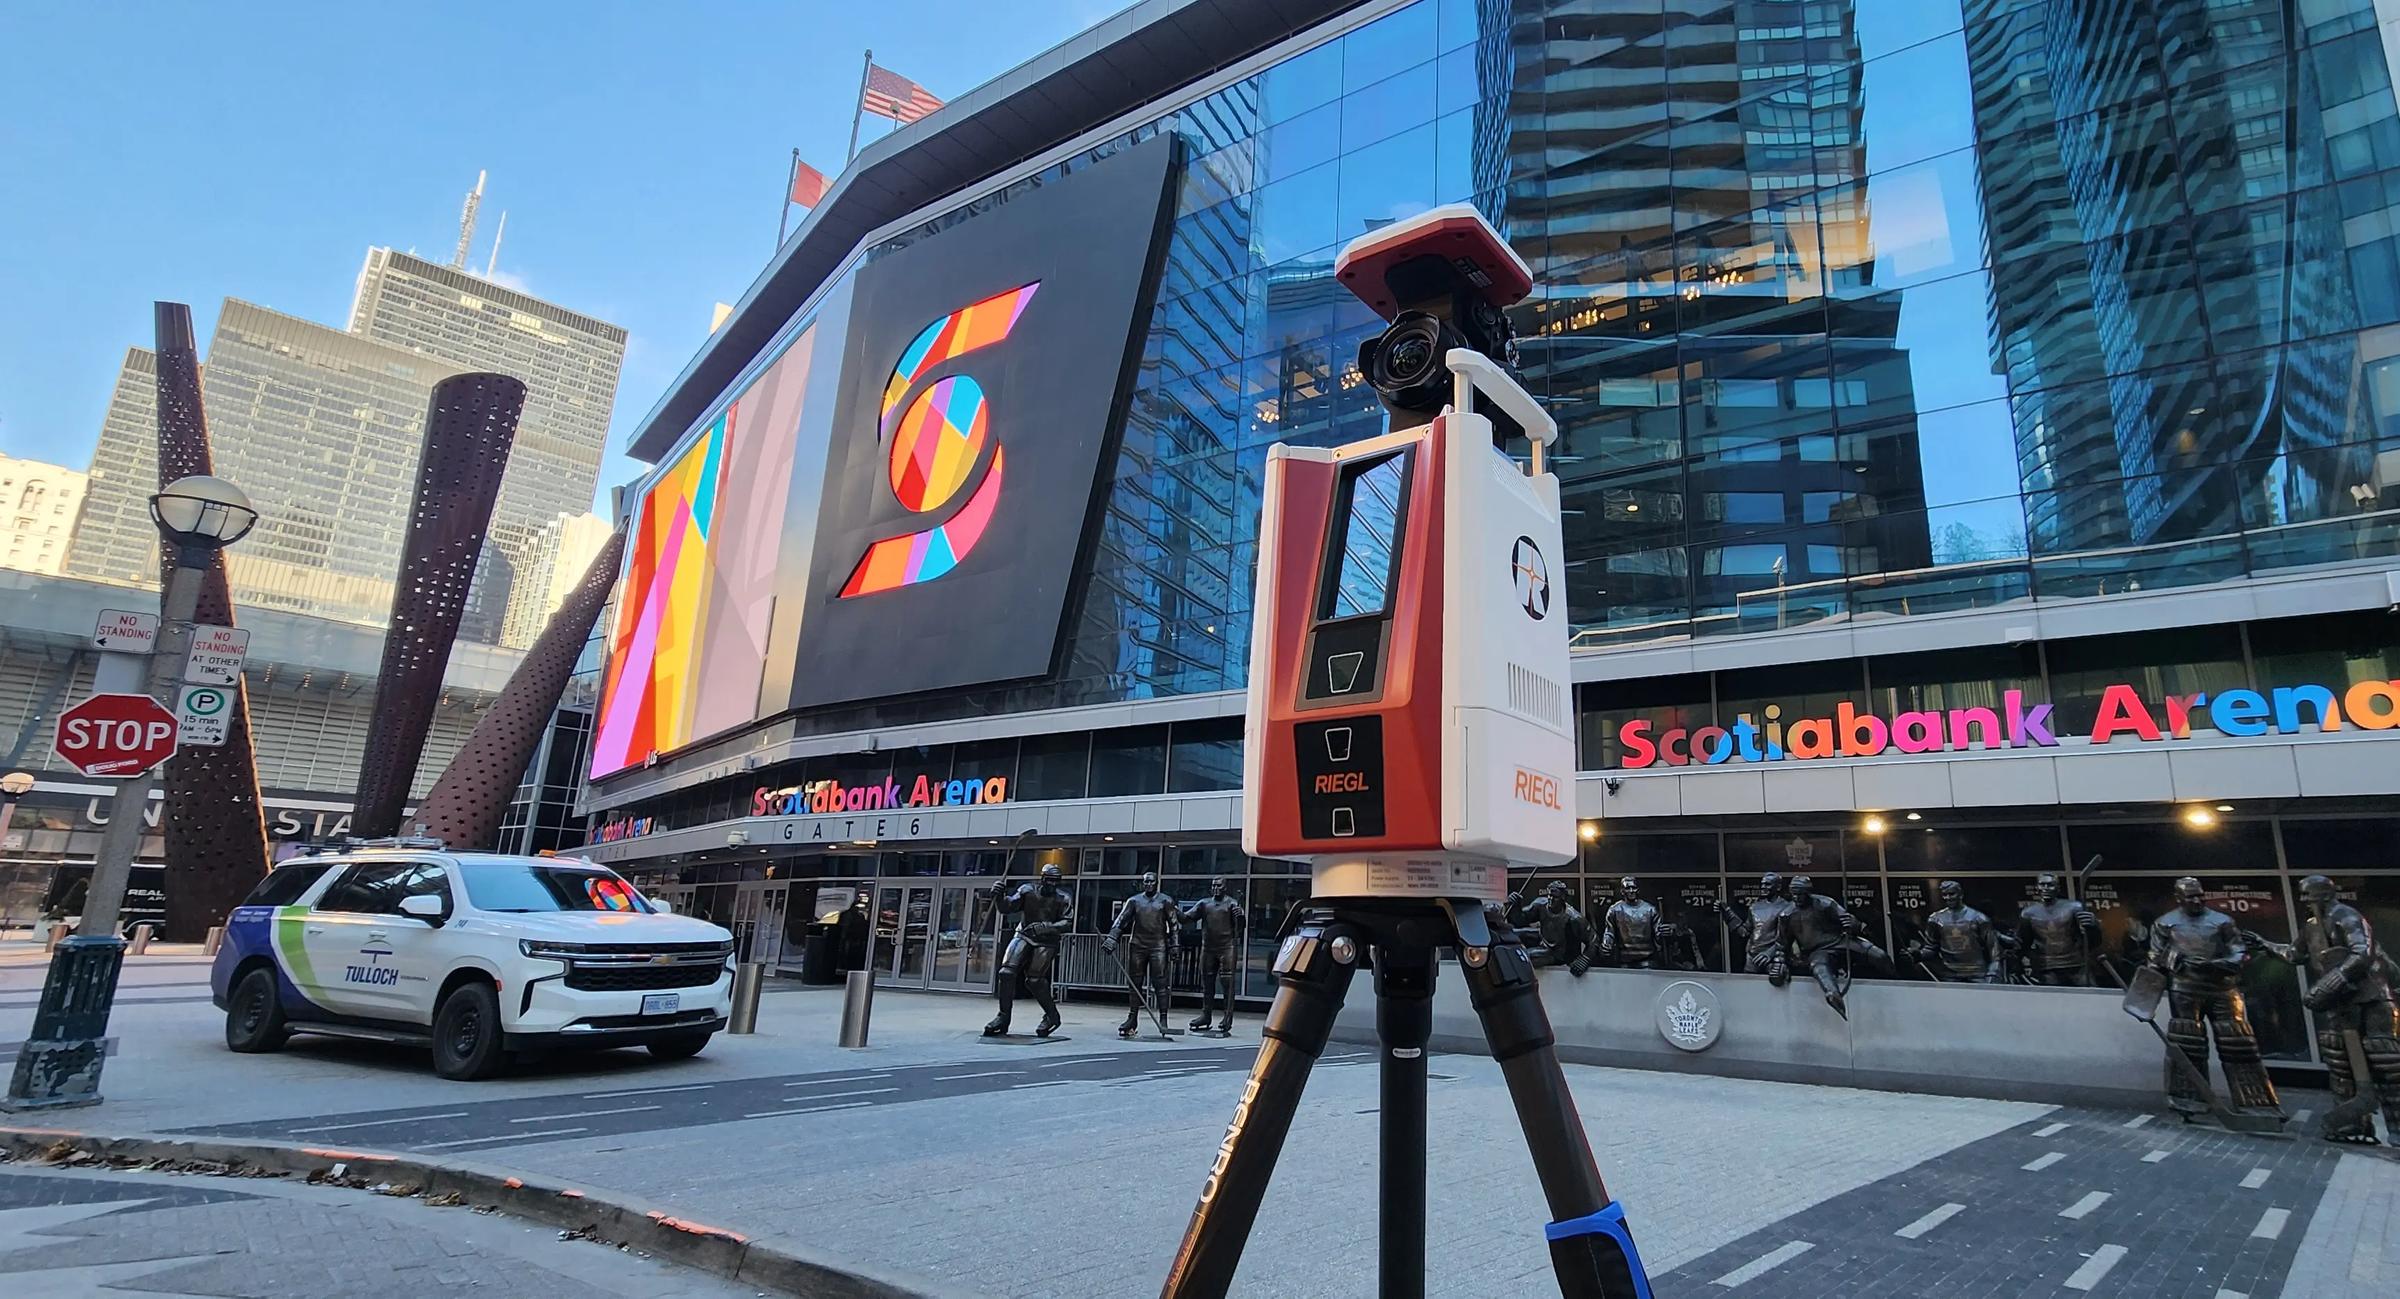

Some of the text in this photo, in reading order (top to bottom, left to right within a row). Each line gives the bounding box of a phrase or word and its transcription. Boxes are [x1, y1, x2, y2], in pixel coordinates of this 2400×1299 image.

[119, 615, 137, 626] NO
[98, 625, 153, 640] STANDING
[213, 631, 231, 642] NO
[194, 641, 244, 656] STANDING
[191, 655, 240, 667] AT OTHER
[199, 665, 228, 676] TIMES
[197, 694, 215, 709] P
[184, 715, 219, 725] 15 min
[1620, 679, 2400, 769] Scotiabank Arena
[63, 718, 172, 751] STOP
[1314, 771, 1369, 795] RIEGL
[1514, 767, 1562, 811] RIEGL
[751, 774, 1007, 816] Scotiabank Arena
[783, 817, 920, 840] GATE 6
[127, 888, 165, 896] REAL
[345, 965, 399, 985] TULLOCH
[1674, 1014, 1703, 1025] TORONTO
[1200, 1079, 1260, 1203] BENRO
